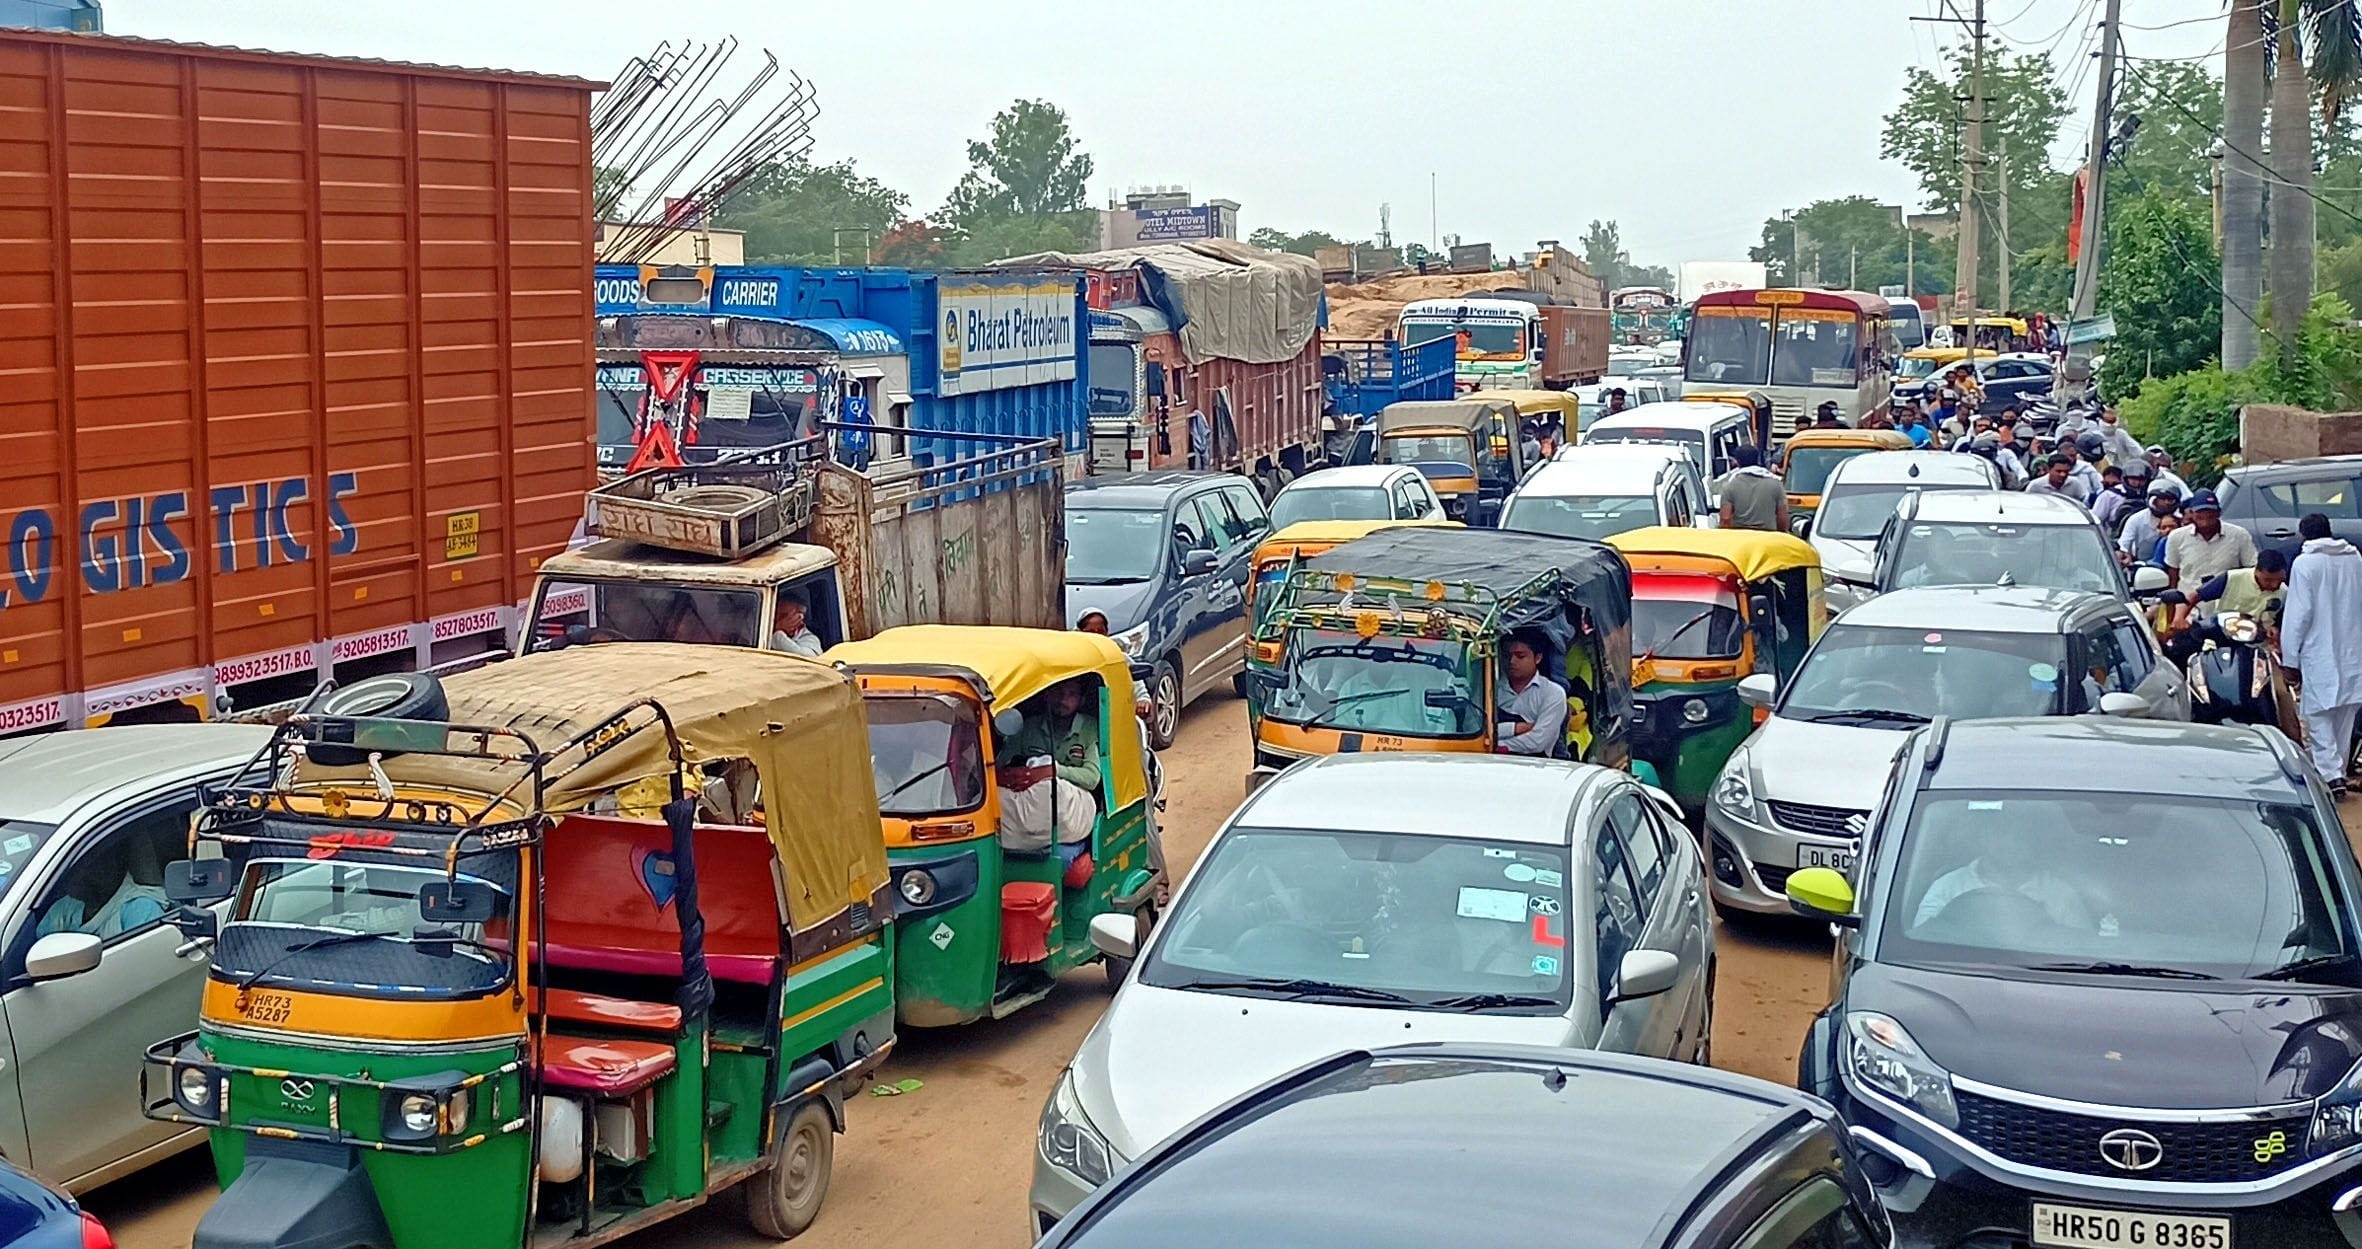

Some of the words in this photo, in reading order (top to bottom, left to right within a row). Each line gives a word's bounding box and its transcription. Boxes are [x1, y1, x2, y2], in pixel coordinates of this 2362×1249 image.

[1145, 217, 1165, 227] OTEL
[1167, 215, 1206, 227] MIDTOWN
[594, 279, 640, 304] OODS
[722, 281, 778, 306] CARRIER
[1421, 306, 1433, 314] All
[1435, 306, 1456, 314] India
[1470, 307, 1507, 316] Permit
[967, 309, 1010, 352] Bharat
[1014, 307, 1070, 349] Petroleum
[0, 472, 358, 609] OGISTICS
[1811, 850, 1828, 867] DL
[1831, 853, 1849, 869] 8C
[935, 931, 950, 941] CNG
[1532, 915, 1567, 949] L
[253, 995, 292, 1009] HR73
[245, 1006, 291, 1023] A5287
[2053, 1211, 2120, 1243] HR50
[2130, 1220, 2145, 1244] G
[2155, 1222, 2224, 1249] 8365
